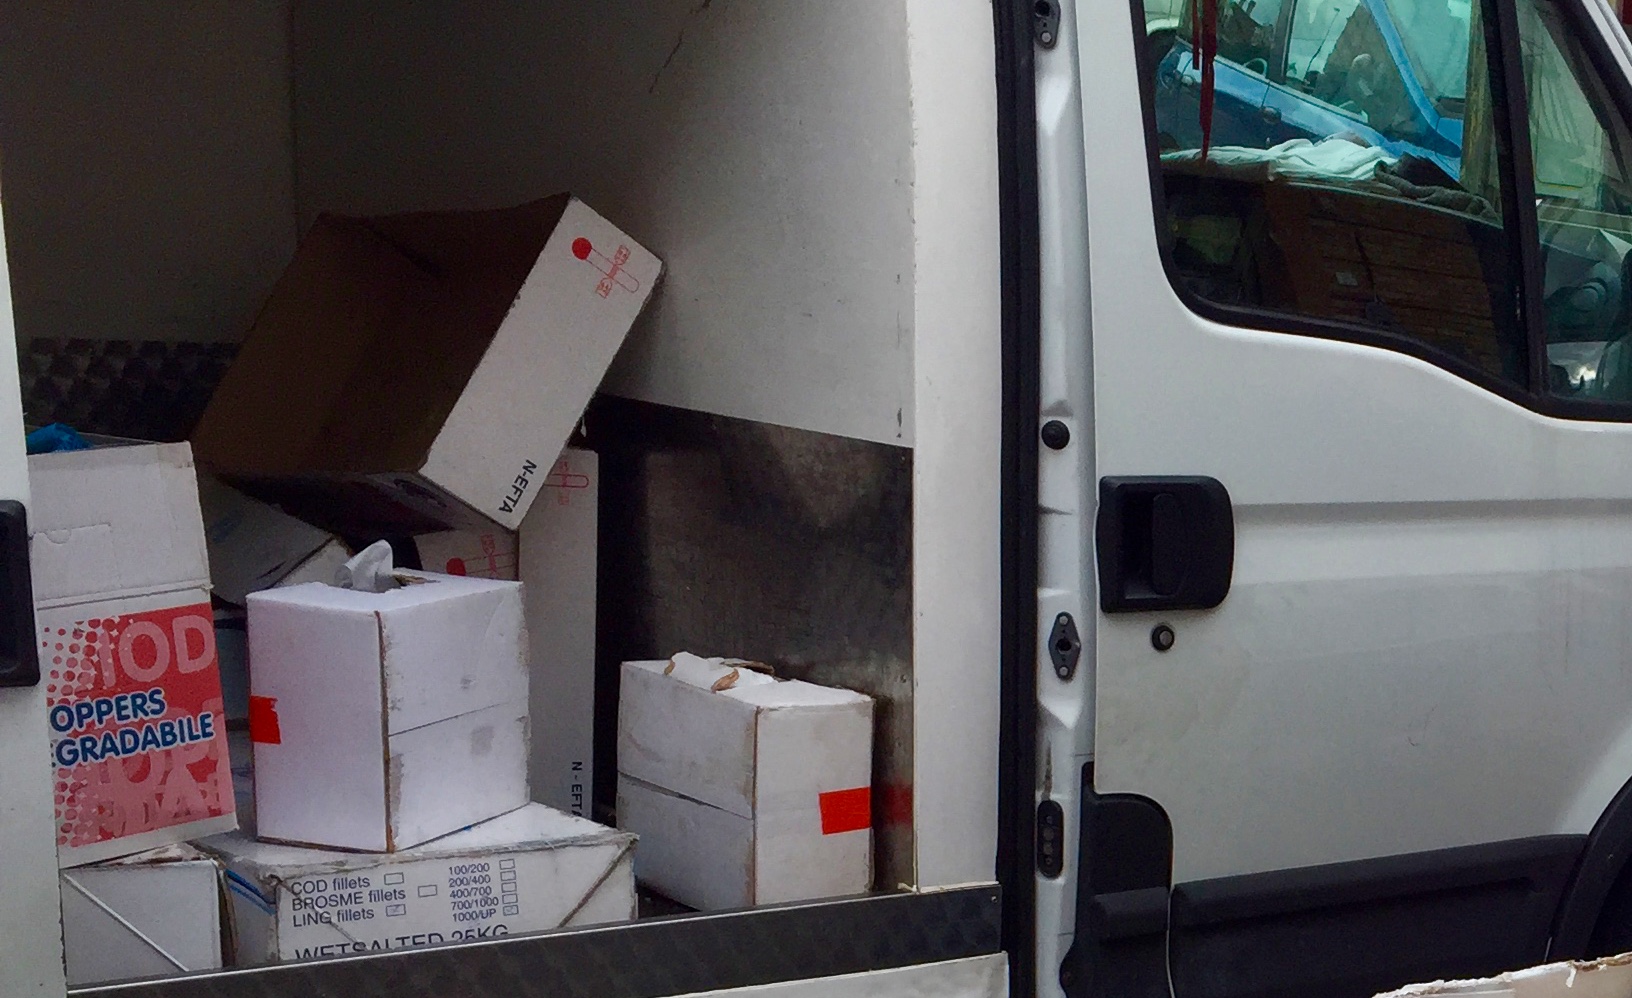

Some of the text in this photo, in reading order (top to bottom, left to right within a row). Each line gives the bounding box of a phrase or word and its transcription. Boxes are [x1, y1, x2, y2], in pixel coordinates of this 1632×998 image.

[499, 459, 537, 513] N-EFTA
[50, 688, 166, 732] OPPERS
[449, 862, 490, 875] 100/200
[291, 876, 371, 896] COD fillets
[449, 874, 491, 888] 200/400
[292, 888, 406, 911] BROSME fillets
[450, 885, 492, 899] 400/700
[451, 896, 499, 911] 700/1000
[293, 907, 375, 928] LING fillets
[453, 908, 497, 922] 1000/UP
